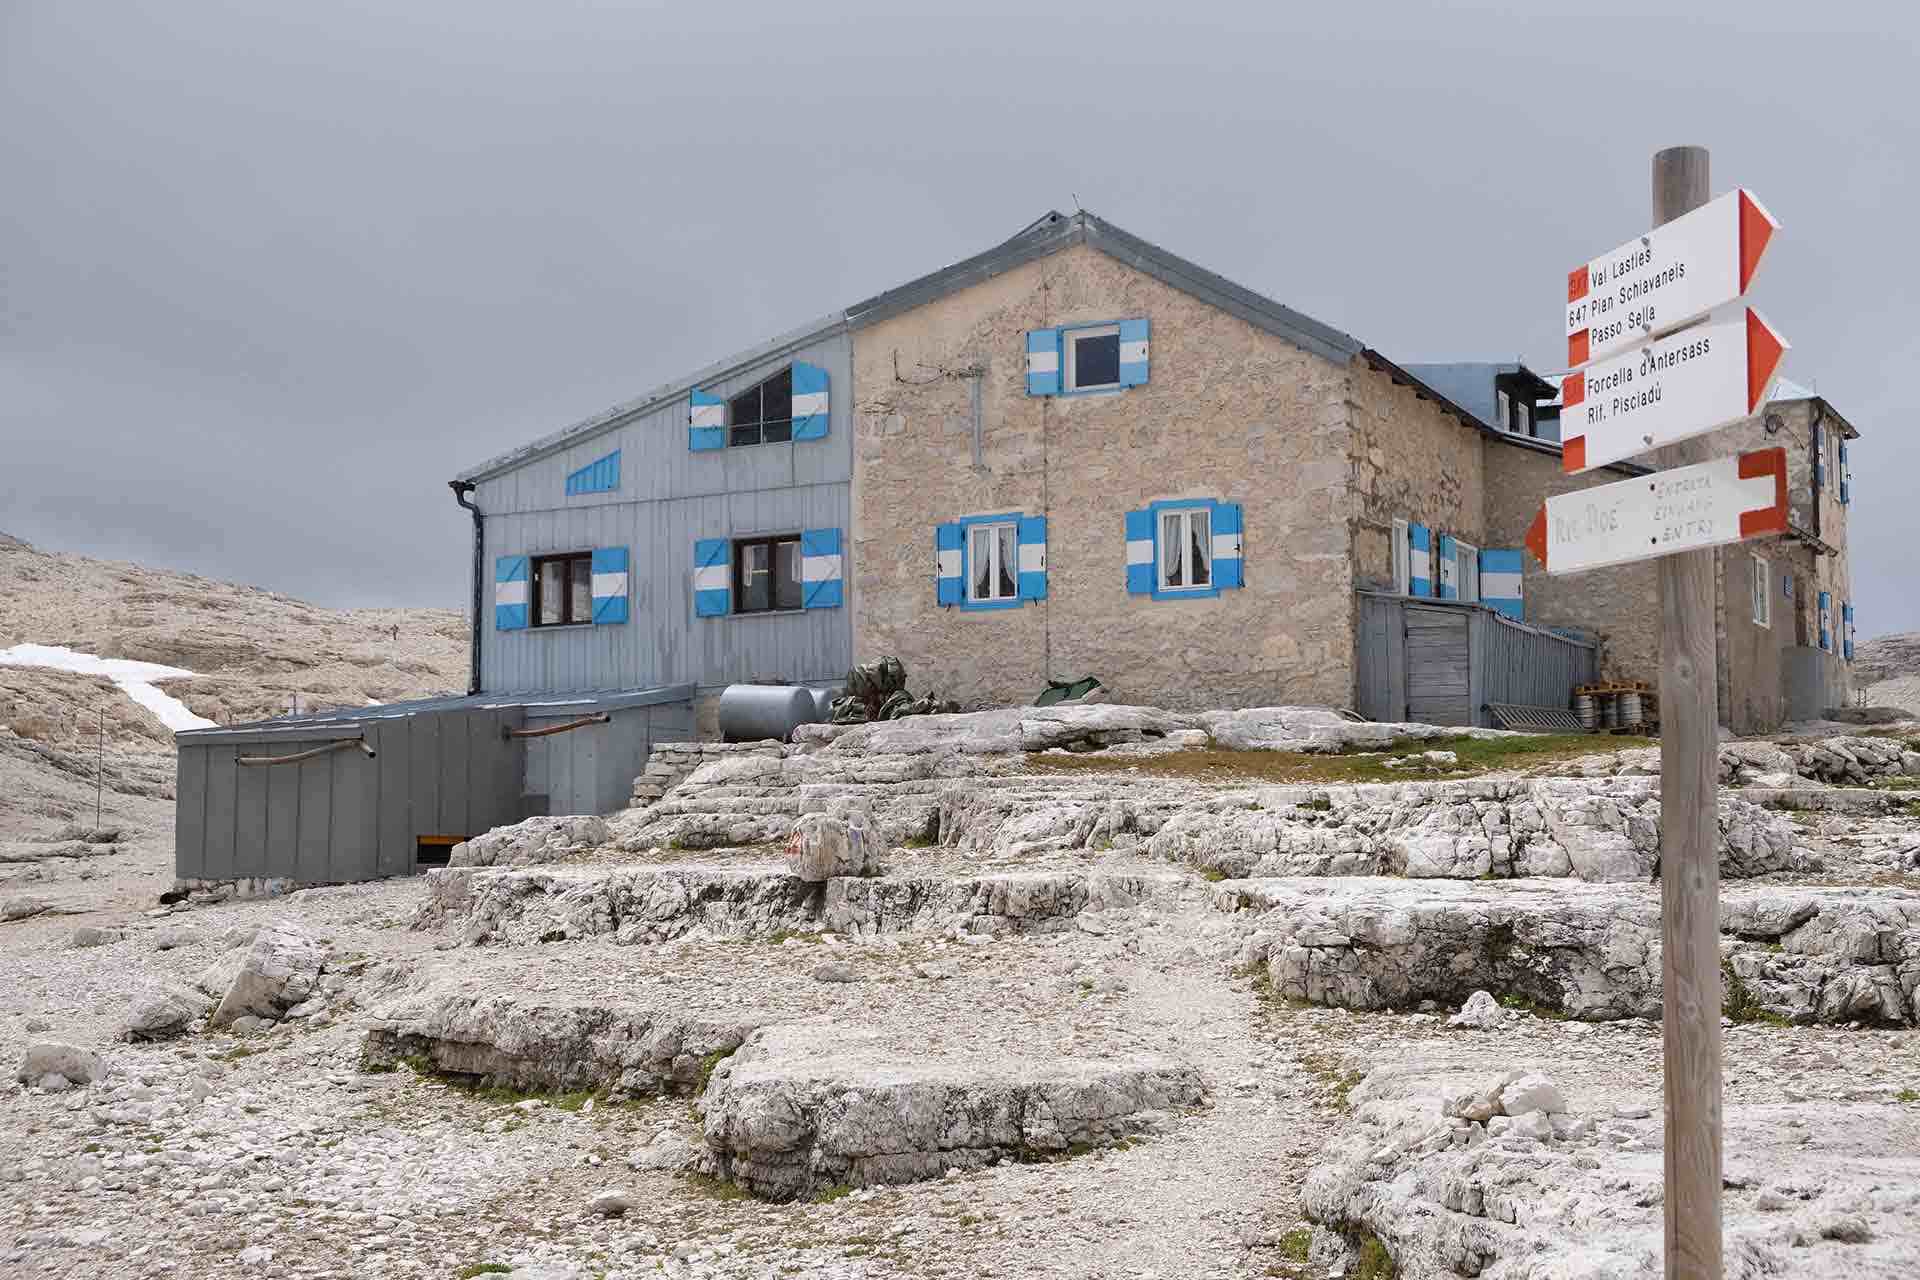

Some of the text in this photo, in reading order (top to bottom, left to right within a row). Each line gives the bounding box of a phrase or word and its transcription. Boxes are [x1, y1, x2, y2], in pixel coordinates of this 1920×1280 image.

[1592, 264, 1607, 288] Val
[1613, 248, 1651, 279] Lasties
[1569, 304, 1587, 327] 647
[1619, 261, 1685, 304] Schiavaneis
[1592, 305, 1655, 345] Passo Sella
[1588, 338, 1710, 397] Forcella d'Antersass
[1588, 402, 1607, 424] Rif.
